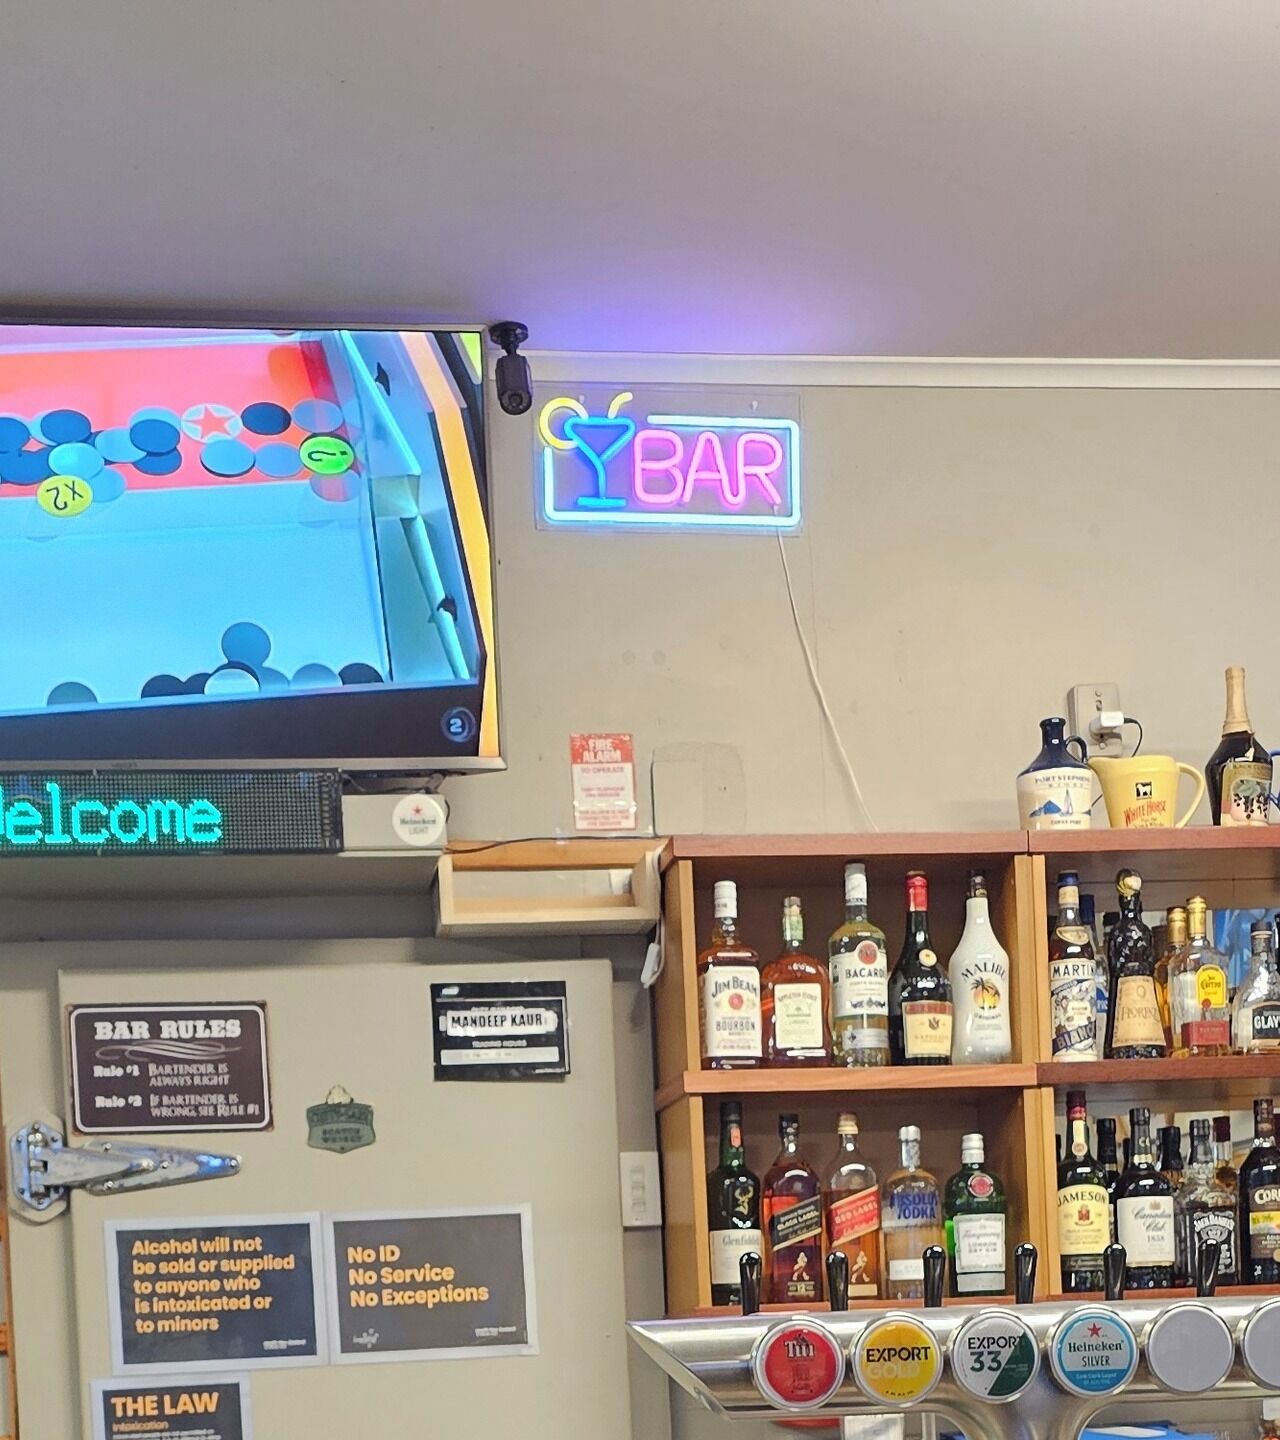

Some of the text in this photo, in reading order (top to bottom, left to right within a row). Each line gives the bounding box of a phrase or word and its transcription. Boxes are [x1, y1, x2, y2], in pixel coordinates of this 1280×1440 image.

[634, 428, 782, 505] BAR
[447, 716, 463, 733] 2
[583, 749, 622, 762] ALARM
[1123, 807, 1145, 827] WHITE
[1146, 800, 1167, 816] HORSE
[712, 980, 730, 998] JIM
[451, 1013, 542, 1028] MANDEEP KAUR
[716, 1020, 756, 1032] BOURBON
[93, 1019, 241, 1040] BAR RULES
[93, 1065, 124, 1078] Rule
[95, 1096, 125, 1108] Rule
[1057, 1192, 1106, 1208] JAMESON
[897, 1208, 936, 1221] VODKA
[132, 1237, 262, 1255] Alcohol will not
[347, 1245, 401, 1263] No ID
[132, 1254, 295, 1275] be sold or supplied
[348, 1263, 455, 1286] No Service
[134, 1275, 261, 1297] to anyone who
[135, 1294, 272, 1313] is intoxicated or
[350, 1284, 489, 1309] No Exceptions
[136, 1316, 219, 1333] to minors
[968, 1336, 1023, 1349] EXPORT
[1068, 1341, 1122, 1353] Heineken
[866, 1346, 931, 1362] EXPORT
[970, 1350, 1002, 1372] 33
[1082, 1355, 1110, 1367] SILVER
[111, 1392, 219, 1417] THE LAW
[112, 1421, 169, 1432] Intoxication
